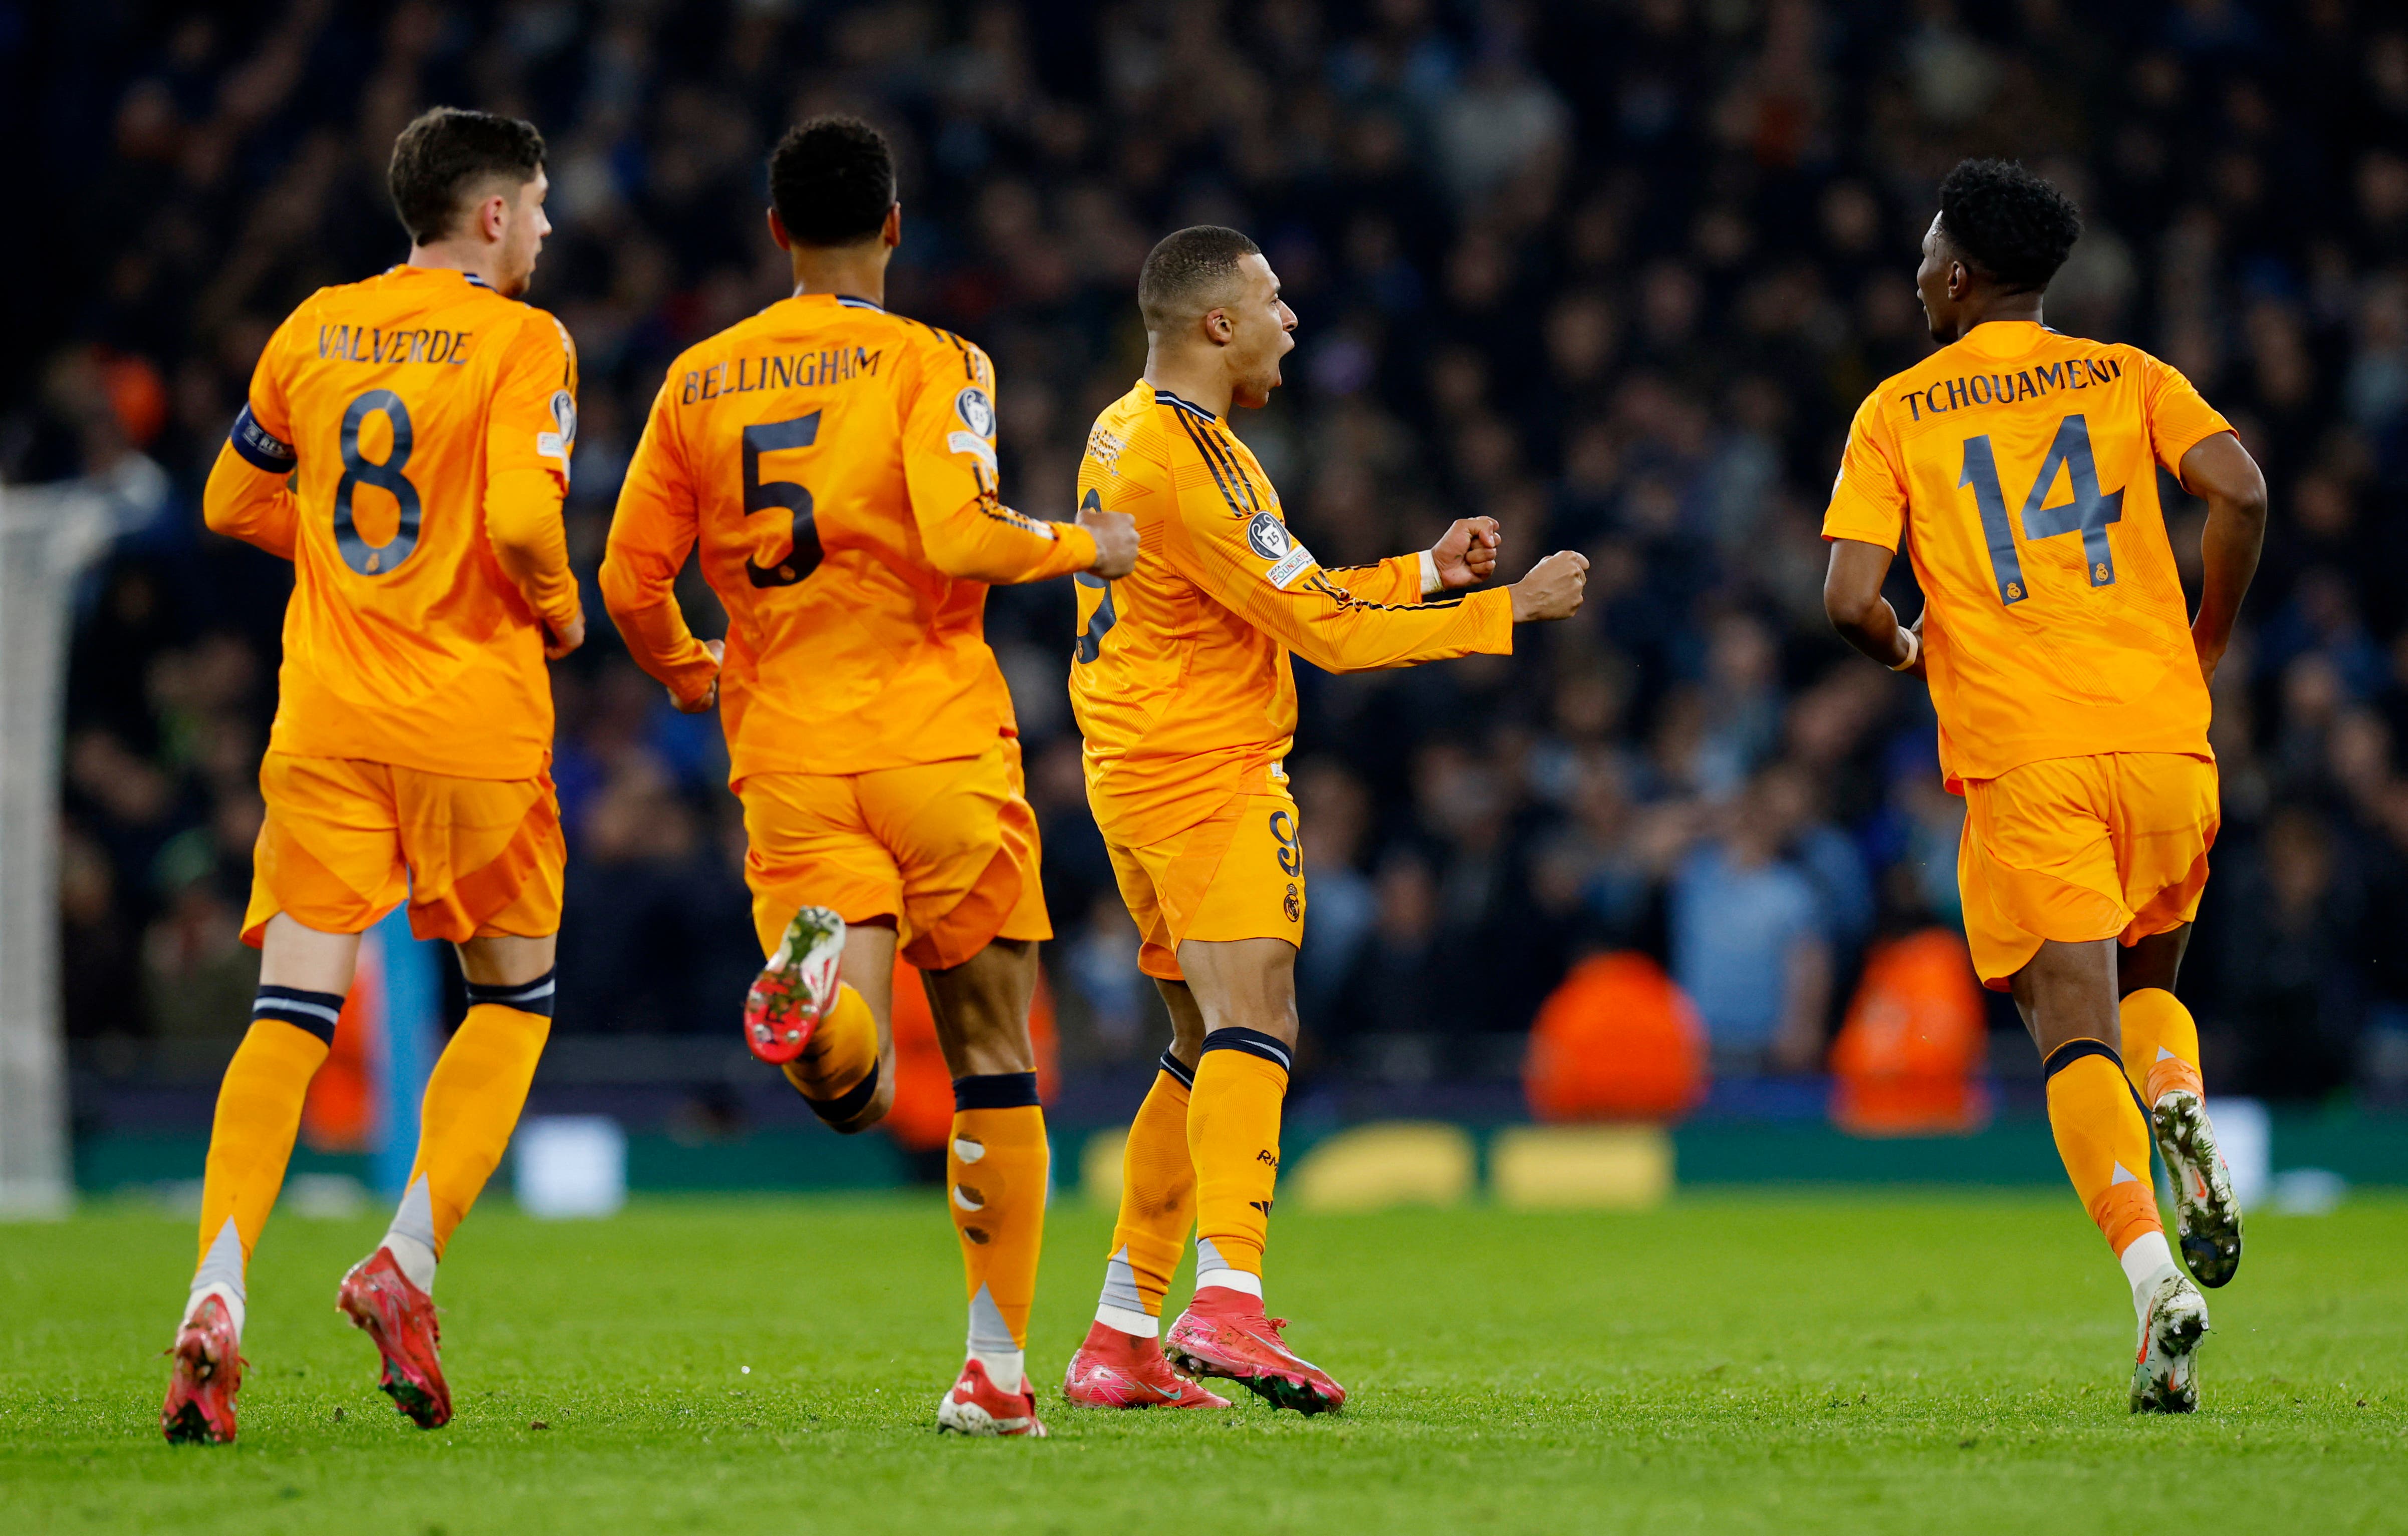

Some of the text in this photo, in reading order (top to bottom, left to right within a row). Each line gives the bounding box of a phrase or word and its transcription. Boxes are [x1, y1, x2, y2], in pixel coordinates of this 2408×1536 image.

[318, 324, 472, 365] VALVERDE
[682, 346, 883, 405] BELLINGHAM
[1899, 358, 2122, 421] TCHOUAMENI
[334, 389, 422, 576] 8
[743, 409, 825, 589] 5
[1957, 414, 2125, 607] 14
[1267, 531, 1280, 547] 15
[1268, 565, 1282, 578] UEFA
[1270, 811, 1301, 878] 9
